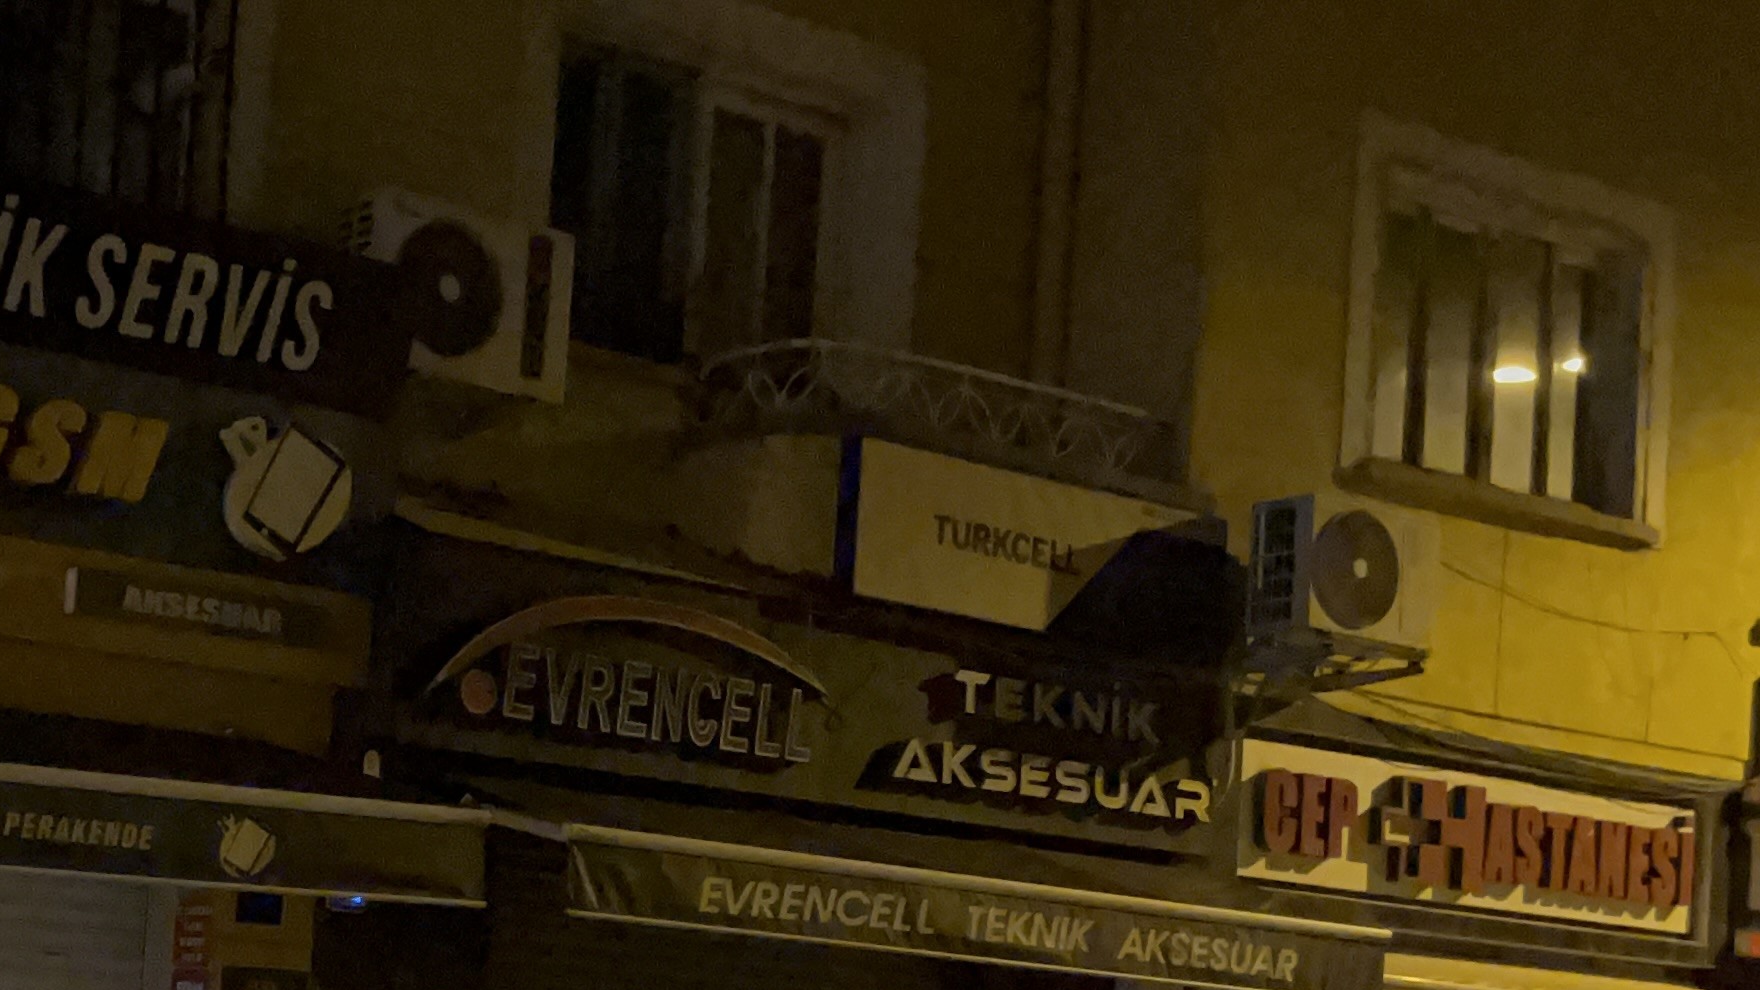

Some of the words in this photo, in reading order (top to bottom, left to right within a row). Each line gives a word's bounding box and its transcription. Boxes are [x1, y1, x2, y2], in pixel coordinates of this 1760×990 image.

[74, 232, 334, 372] SERVİS
[934, 515, 1081, 575] TURKCELL
[502, 641, 813, 764] EVRENCELL
[955, 669, 1163, 745] TEKNİK
[893, 737, 1212, 824] AKSESUAR
[1263, 768, 1359, 858] CEP
[3, 812, 155, 852] PERAKENDE
[699, 876, 936, 936] EVRENCELL
[1118, 927, 1300, 983] AKSESUAR
